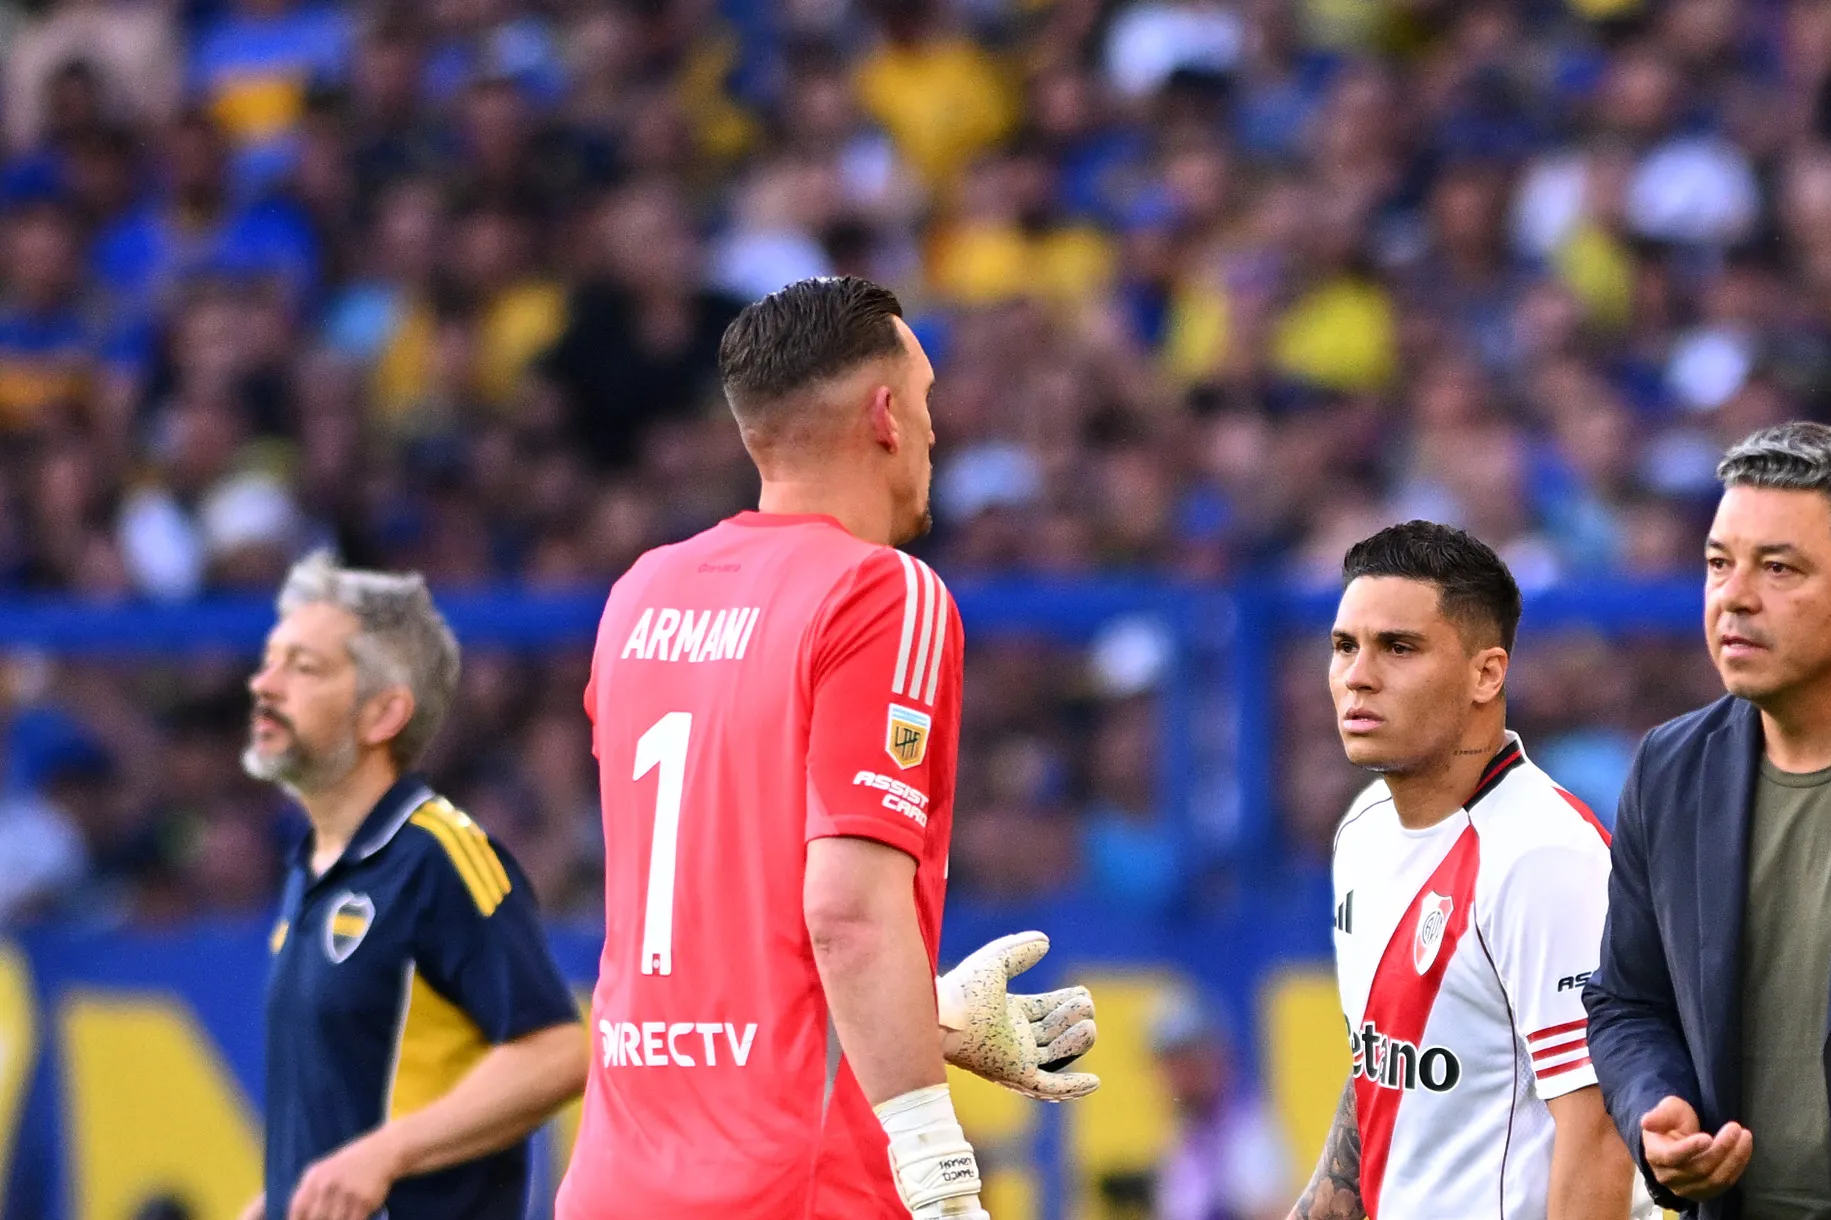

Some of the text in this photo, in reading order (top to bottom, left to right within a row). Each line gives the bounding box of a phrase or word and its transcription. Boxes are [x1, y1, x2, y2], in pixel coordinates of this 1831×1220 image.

[621, 607, 760, 662] ARMANI
[852, 771, 929, 808] ASSIST
[881, 793, 928, 828] CARD
[632, 711, 692, 976] 1
[1343, 1014, 1461, 1093] etano
